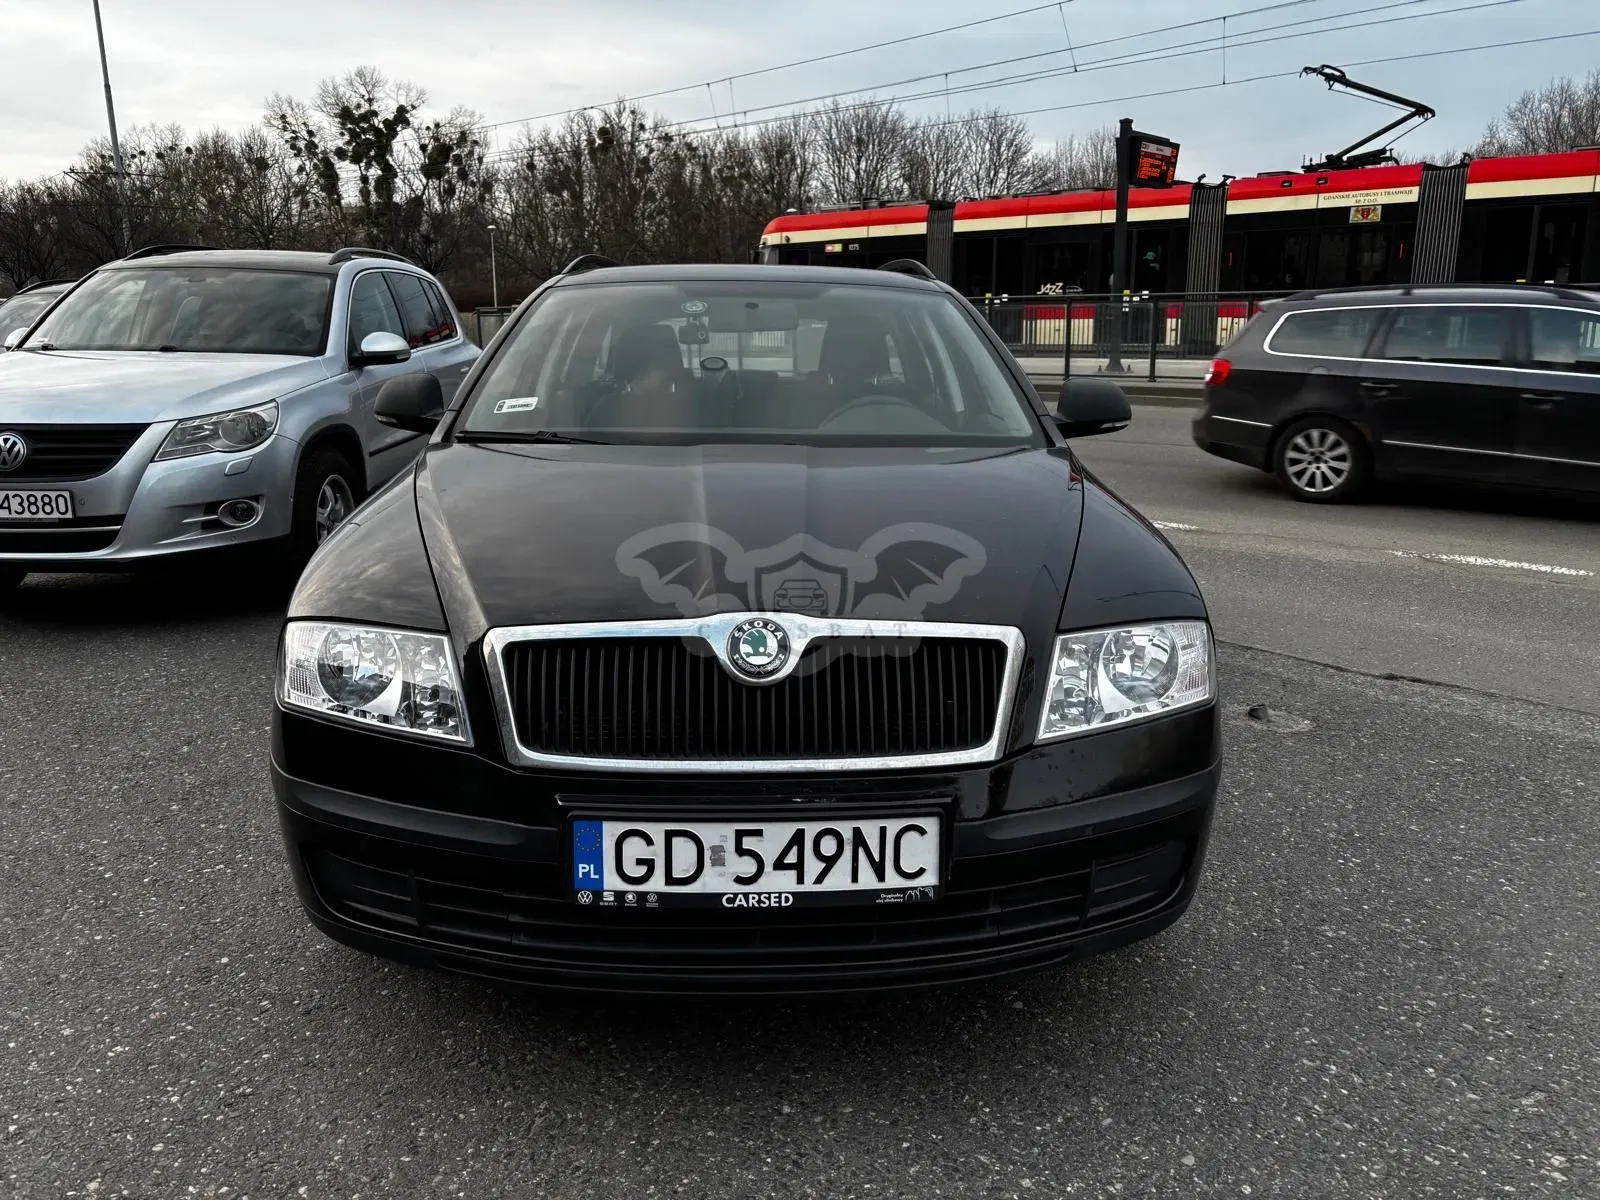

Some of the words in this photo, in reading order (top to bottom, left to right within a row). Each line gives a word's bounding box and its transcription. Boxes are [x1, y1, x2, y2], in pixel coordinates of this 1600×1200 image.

[0, 493, 69, 516] A3880
[614, 828, 706, 887] GD
[732, 823, 928, 886] 549NC
[578, 863, 599, 879] PL
[721, 893, 794, 908] CARSED
